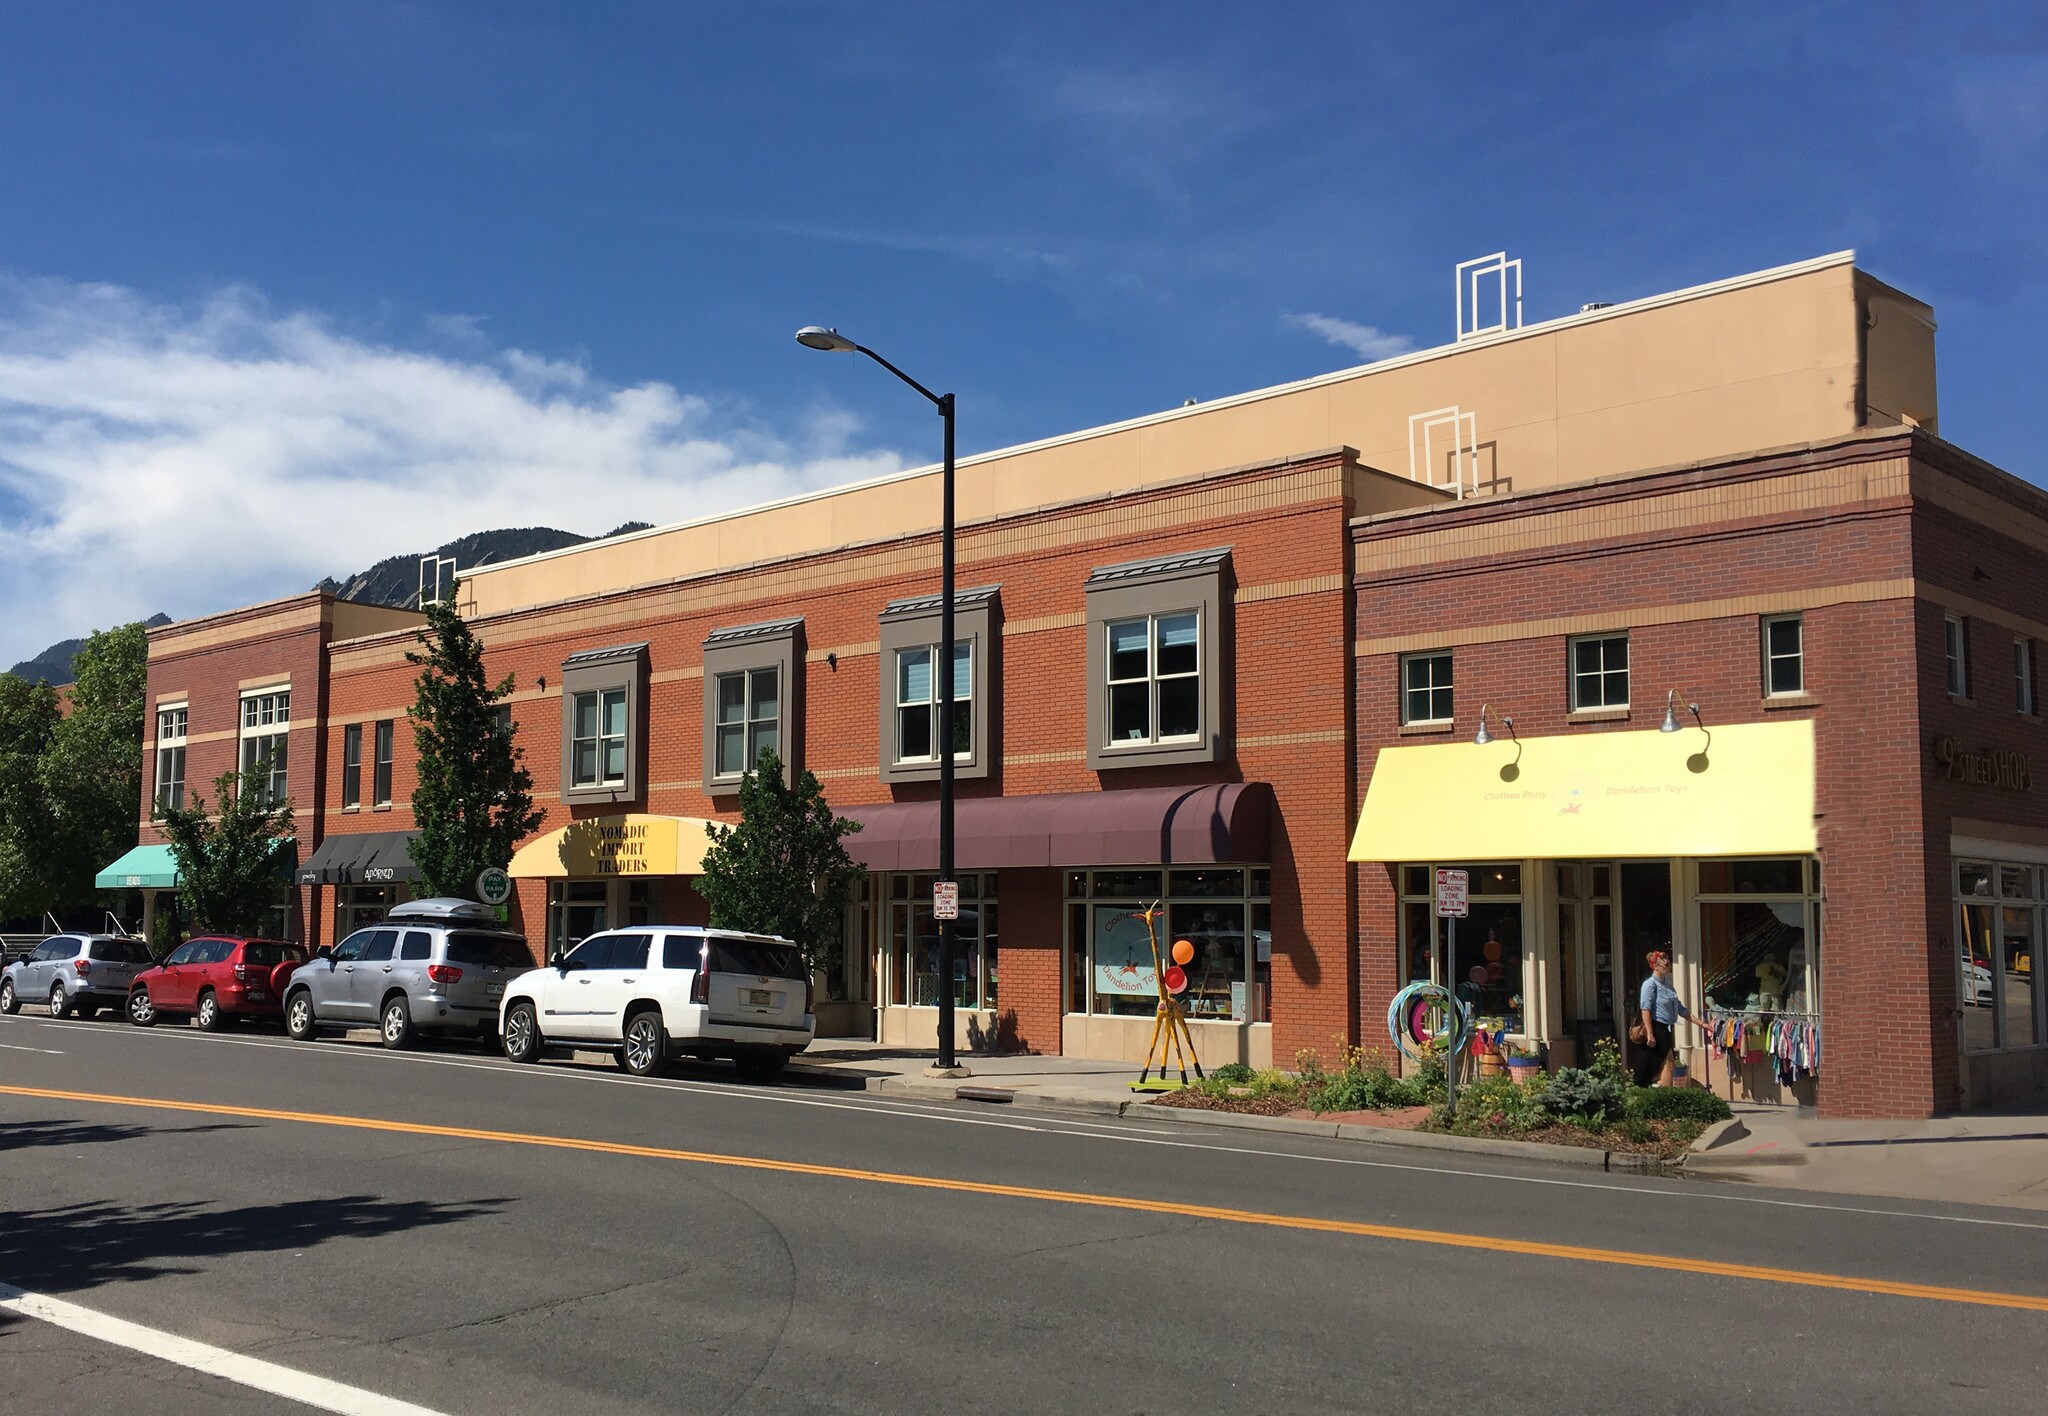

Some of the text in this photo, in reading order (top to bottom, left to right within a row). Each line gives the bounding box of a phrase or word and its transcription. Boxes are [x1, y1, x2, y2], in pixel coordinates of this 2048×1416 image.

[1993, 749, 2033, 792] SHOPS
[1483, 790, 1548, 801] Clothes Pony
[1606, 784, 1689, 796] Dandelion Toys
[600, 825, 649, 840] NOMADIC
[602, 842, 644, 856] IMPORT
[597, 859, 648, 873] TRADERS
[1102, 964, 1143, 992] Dandelion
